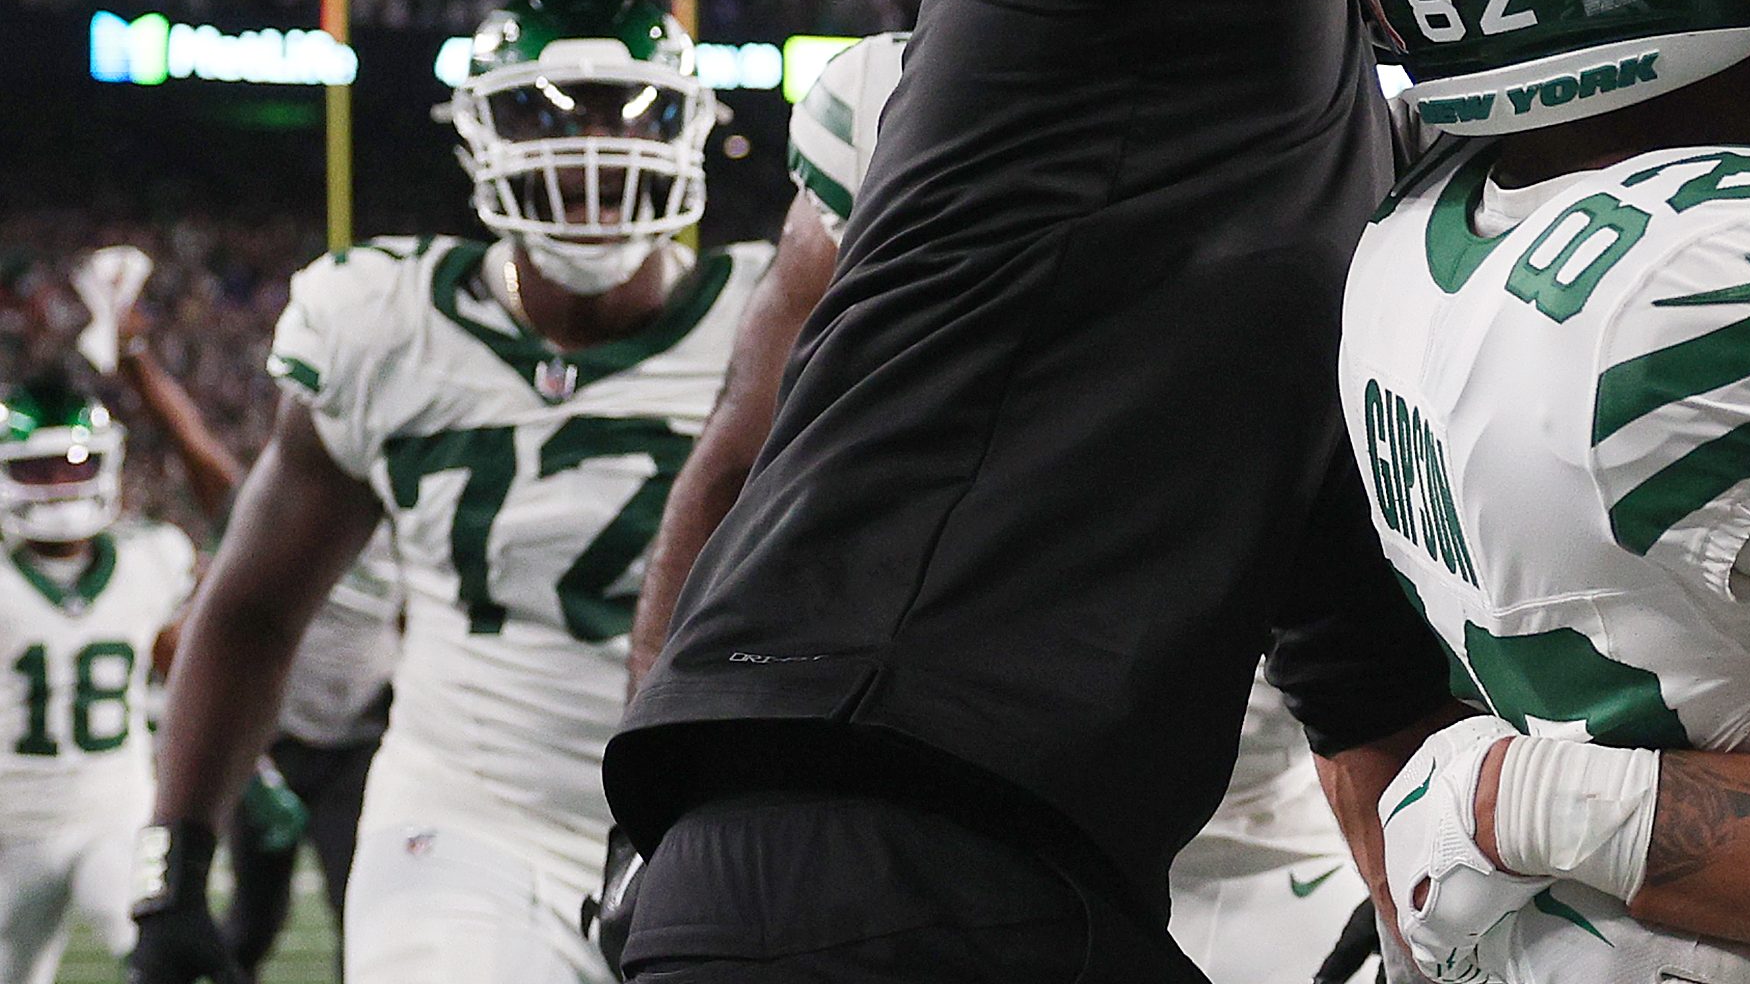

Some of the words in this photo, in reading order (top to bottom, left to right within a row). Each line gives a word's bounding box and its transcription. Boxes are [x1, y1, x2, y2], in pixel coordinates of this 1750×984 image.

[1506, 48, 1660, 116] YORK
[382, 413, 698, 643] 72
[1364, 378, 1480, 591] GIPSON
[11, 640, 136, 757] 18
